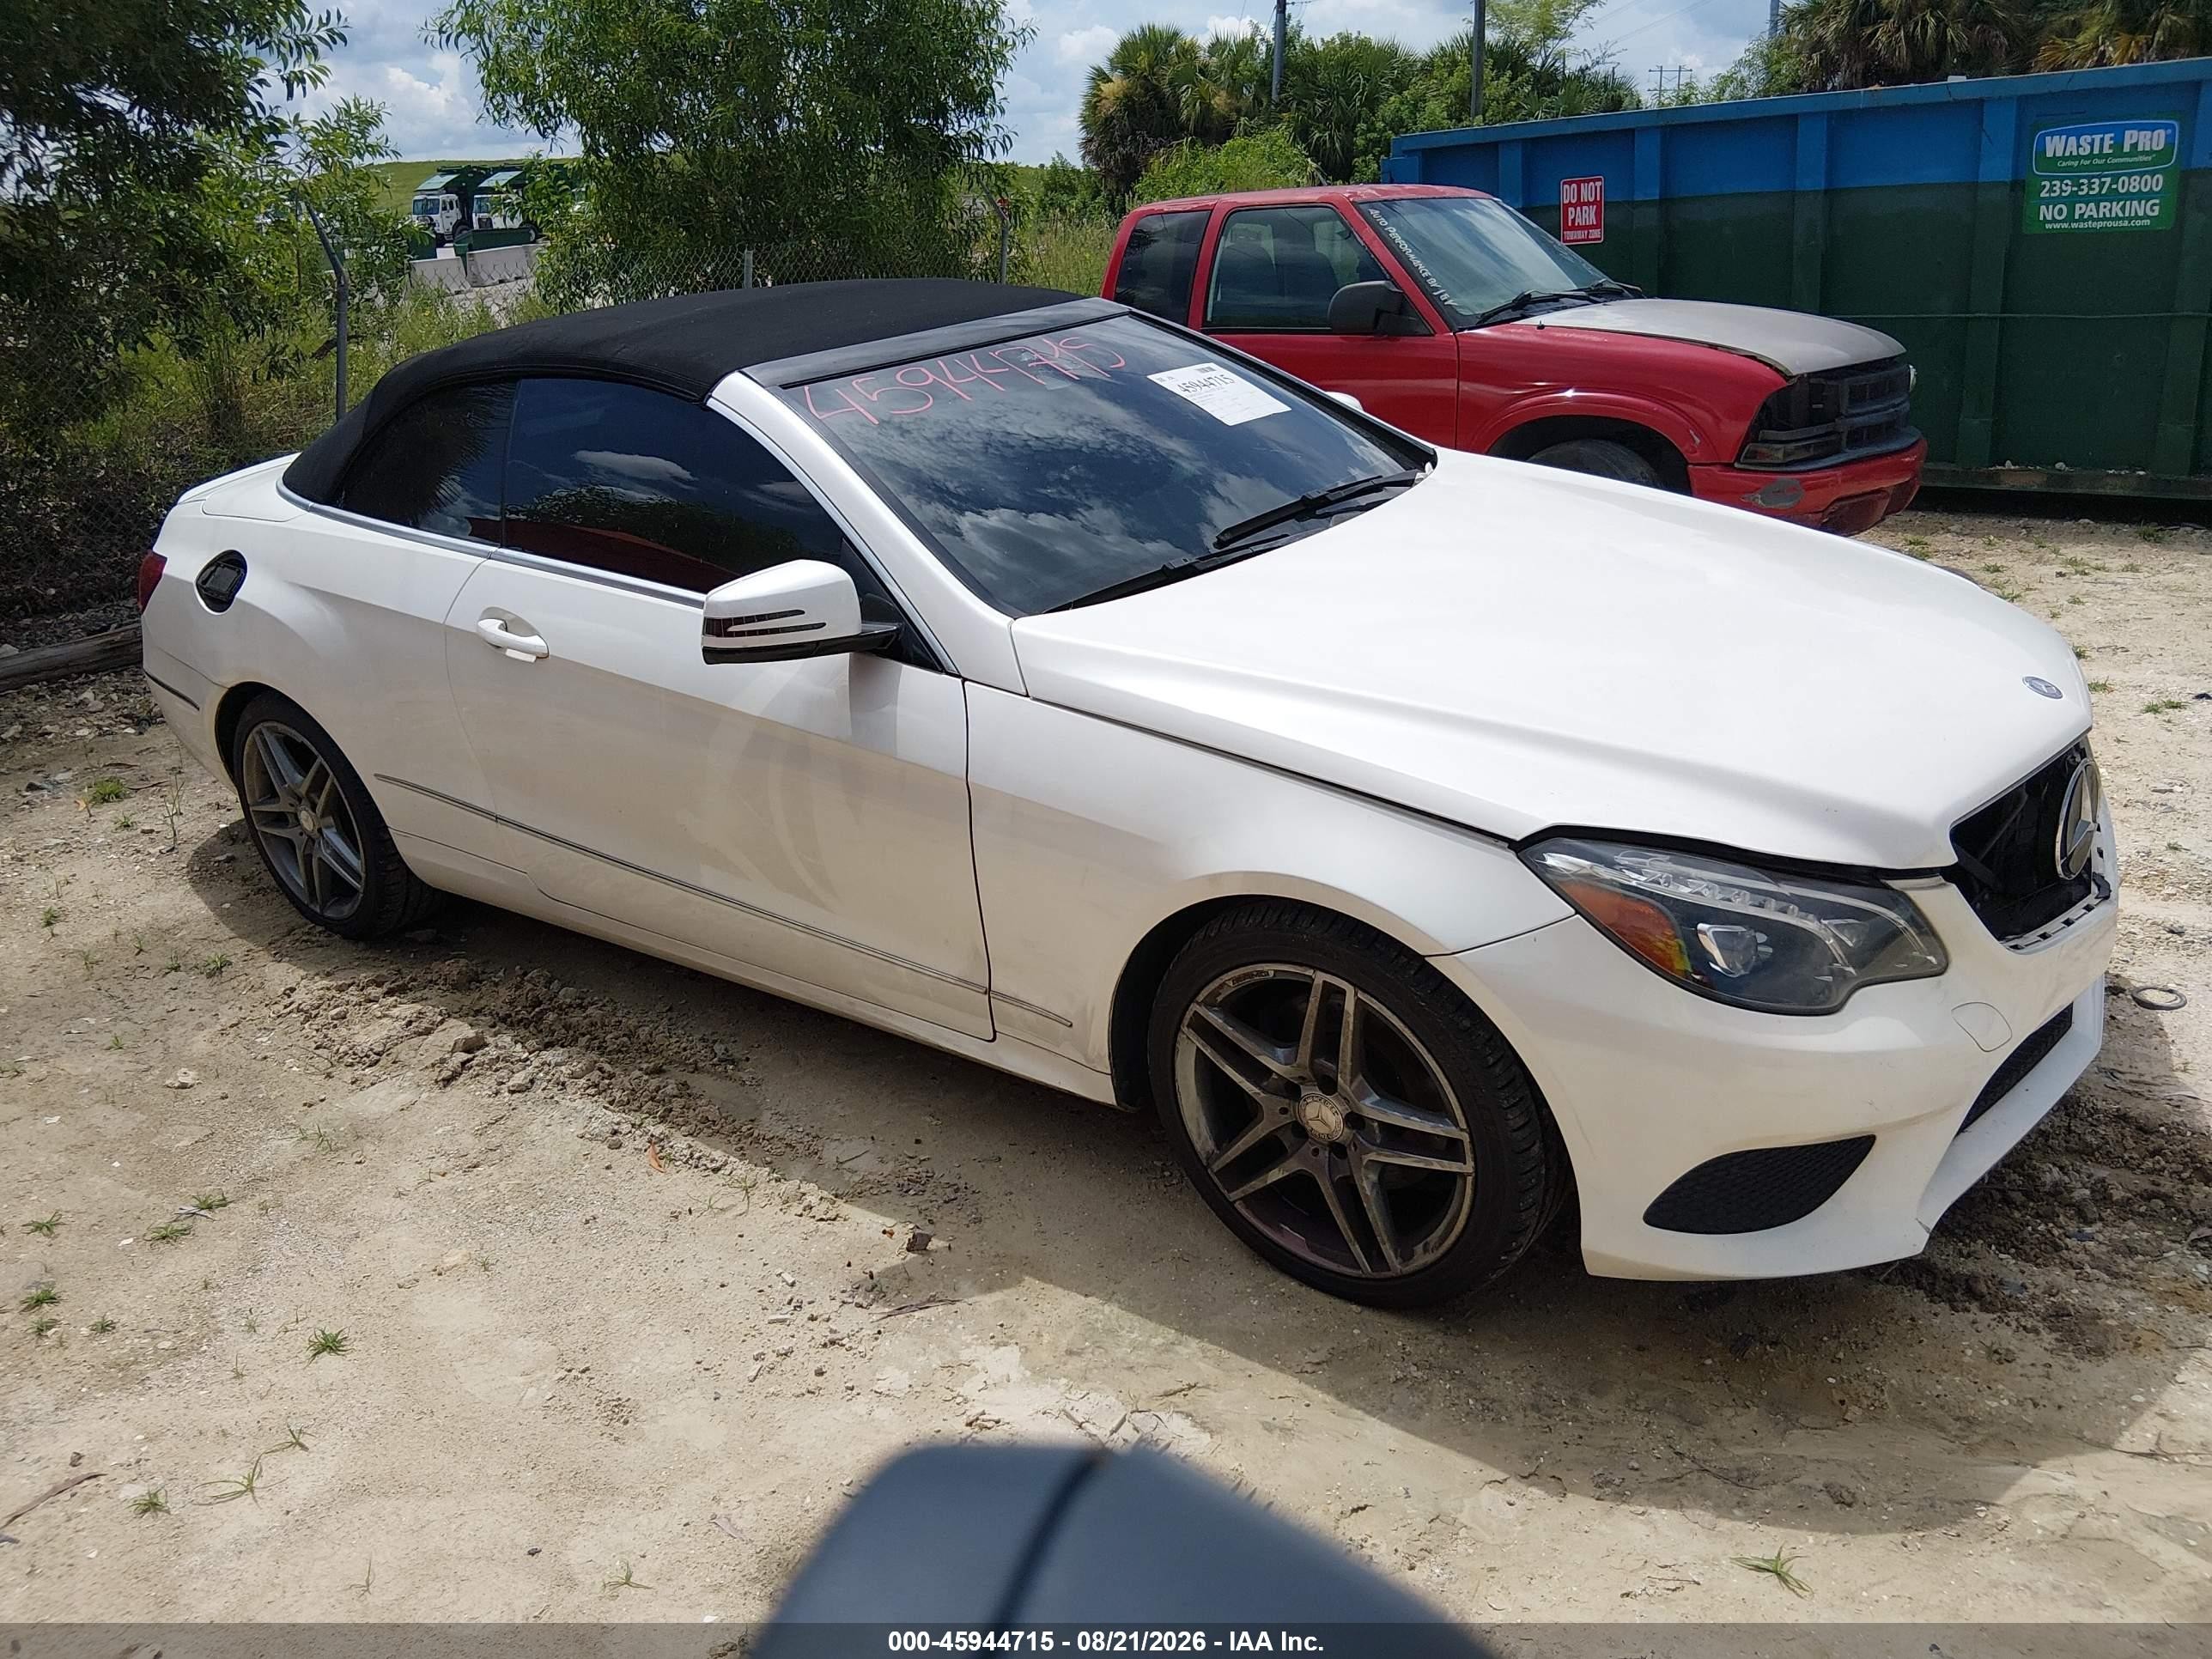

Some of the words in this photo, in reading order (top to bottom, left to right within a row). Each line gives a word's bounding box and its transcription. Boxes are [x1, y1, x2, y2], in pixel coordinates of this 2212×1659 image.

[2045, 133, 2114, 157] WASTE
[2057, 159, 2079, 167] Caring
[1563, 183, 1577, 204] DO
[1580, 181, 1602, 203] NOT
[2039, 174, 2163, 198] 239-337-0800
[1568, 205, 1596, 226] PARK
[2039, 204, 2067, 221] NO
[2075, 199, 2160, 220] PARKING
[2045, 218, 2150, 229] www.wasteprousa.com
[1368, 209, 1389, 227] AUTO
[1384, 226, 1432, 277] PERFORMANCE
[1177, 374, 1235, 393] 45944715
